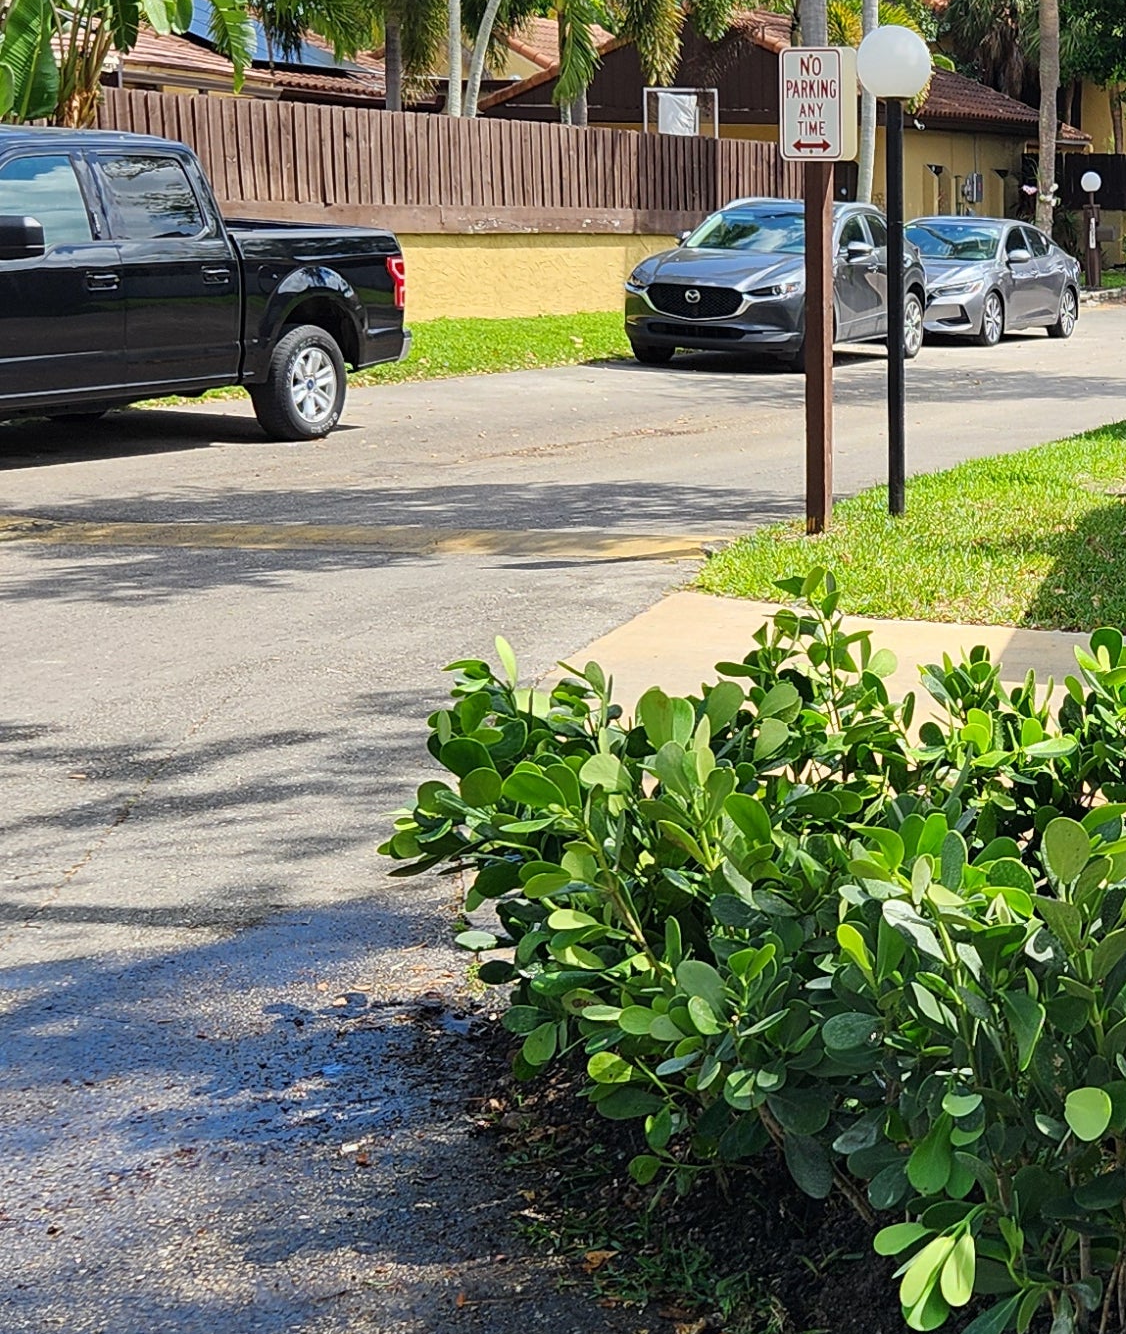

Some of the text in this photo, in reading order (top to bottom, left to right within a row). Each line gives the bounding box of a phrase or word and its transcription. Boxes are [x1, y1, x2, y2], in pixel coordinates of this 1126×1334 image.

[800, 57, 822, 76] NO
[786, 80, 837, 99] PARKING
[799, 103, 824, 118] ANY
[798, 121, 826, 136] TIME
